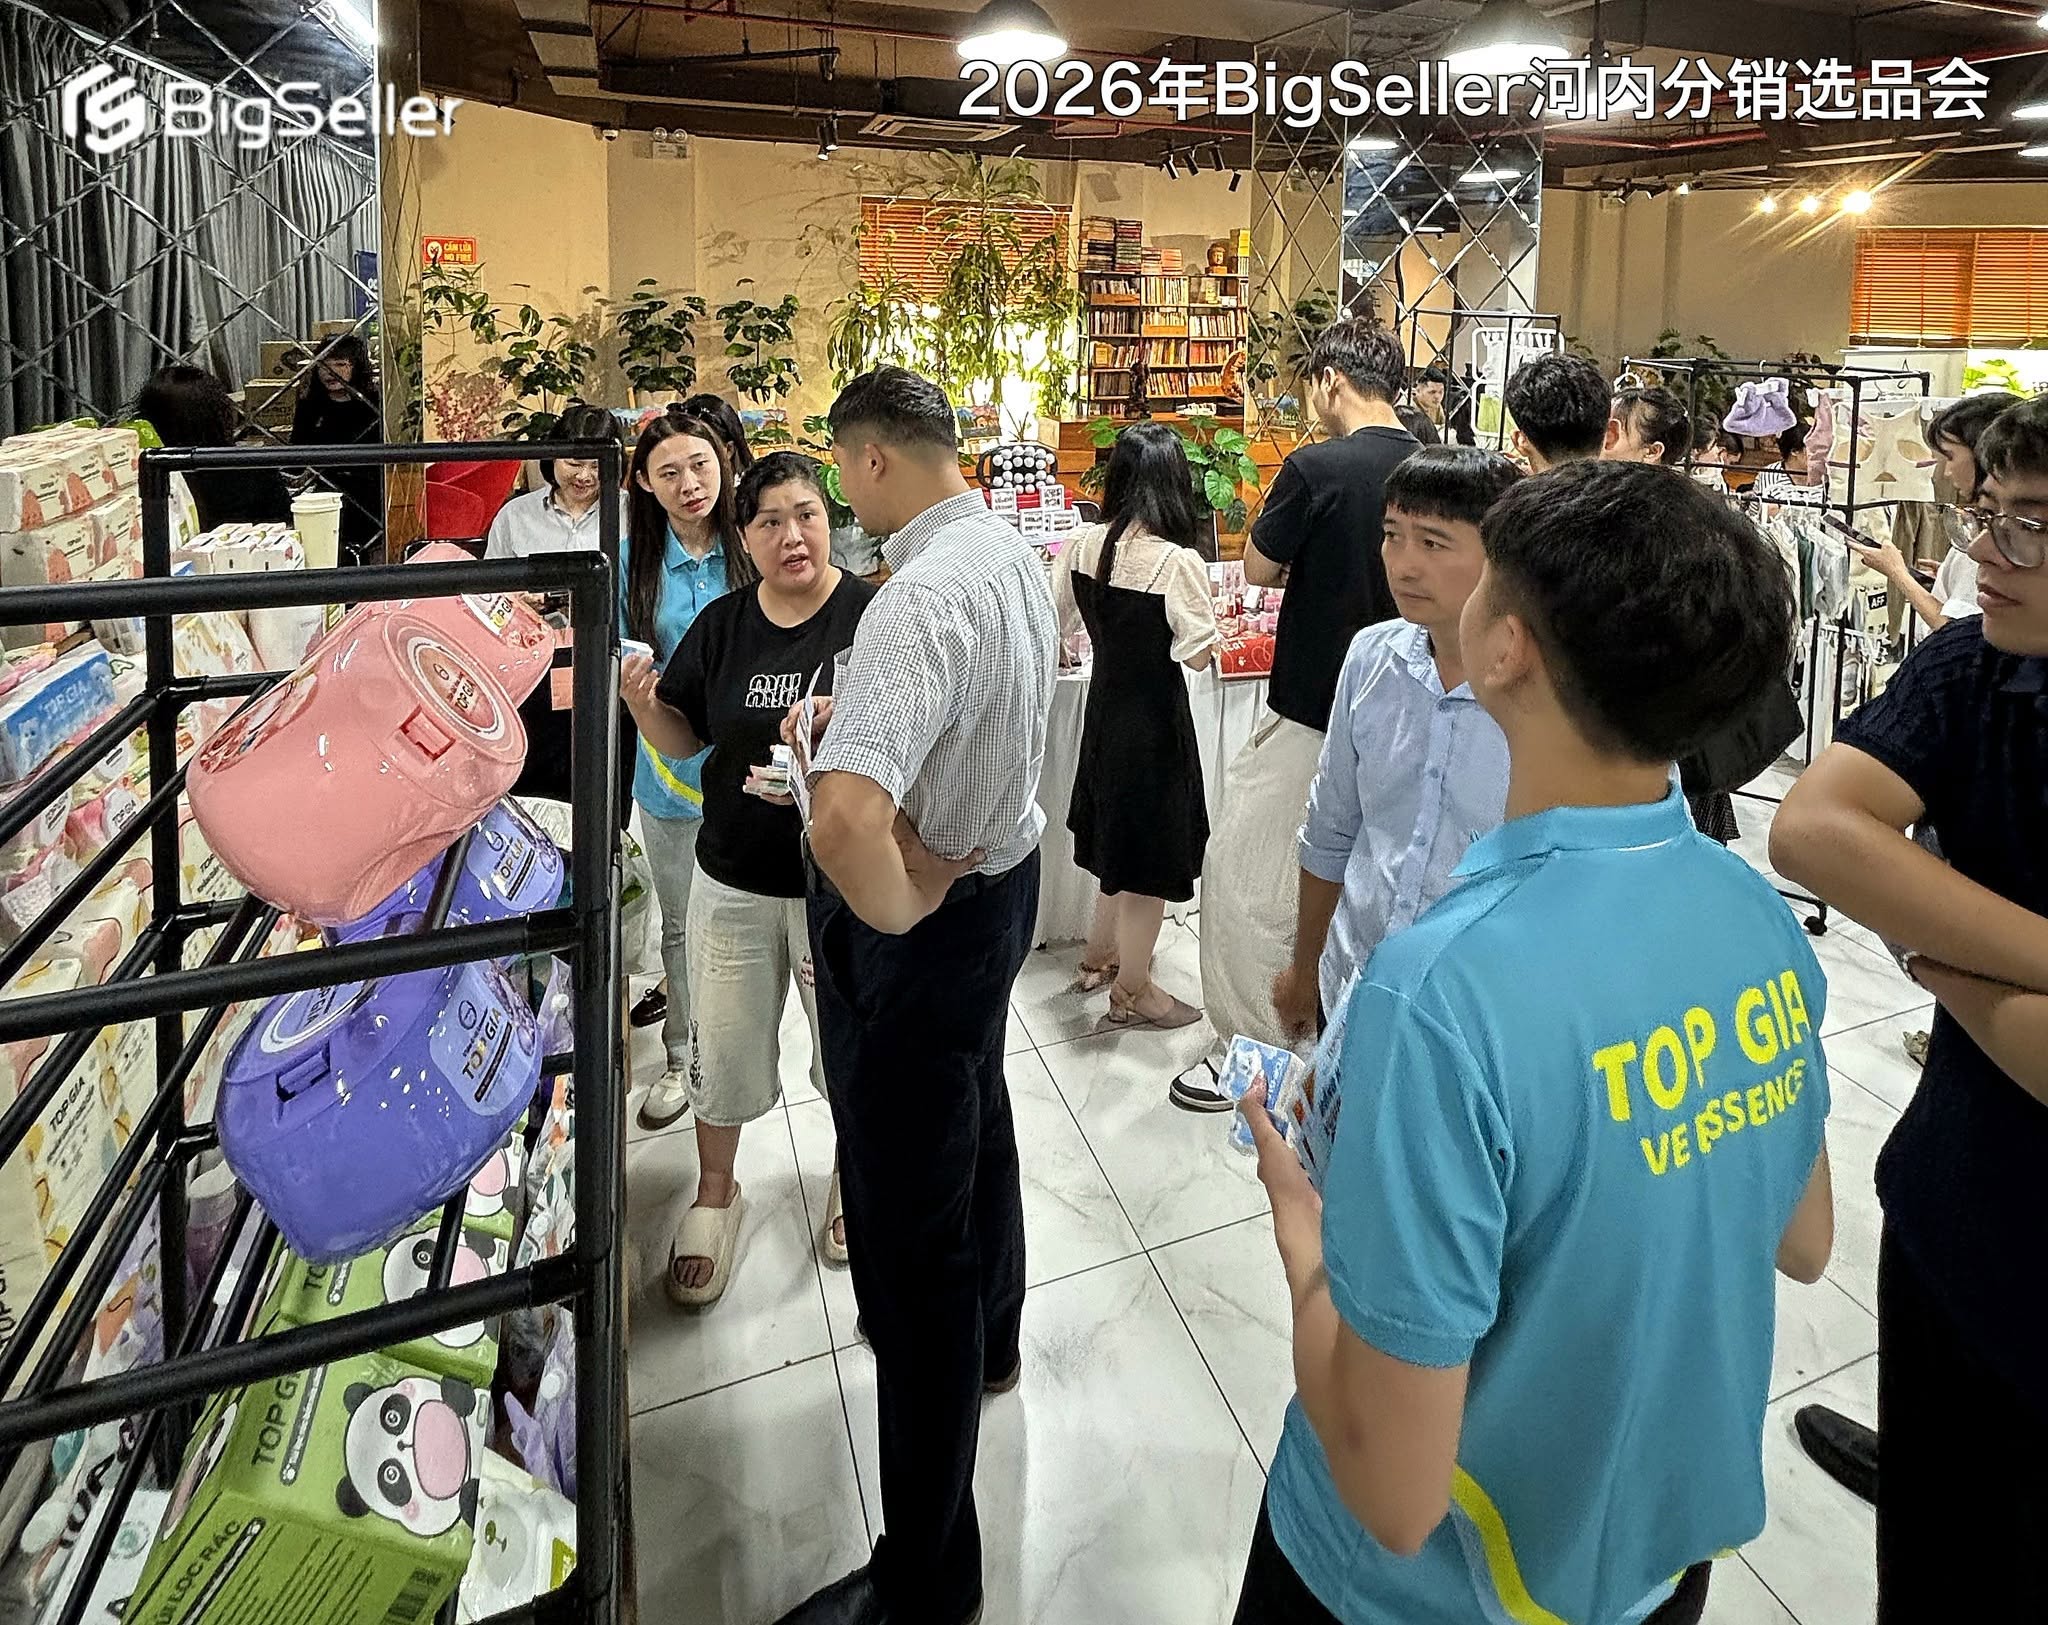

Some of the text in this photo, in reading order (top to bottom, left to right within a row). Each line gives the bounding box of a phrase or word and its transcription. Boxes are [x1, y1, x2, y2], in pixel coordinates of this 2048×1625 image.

[1592, 969, 1812, 1122] TOP GIA
[50, 1098, 69, 1132] TOP
[251, 1374, 300, 1465] TOP G
